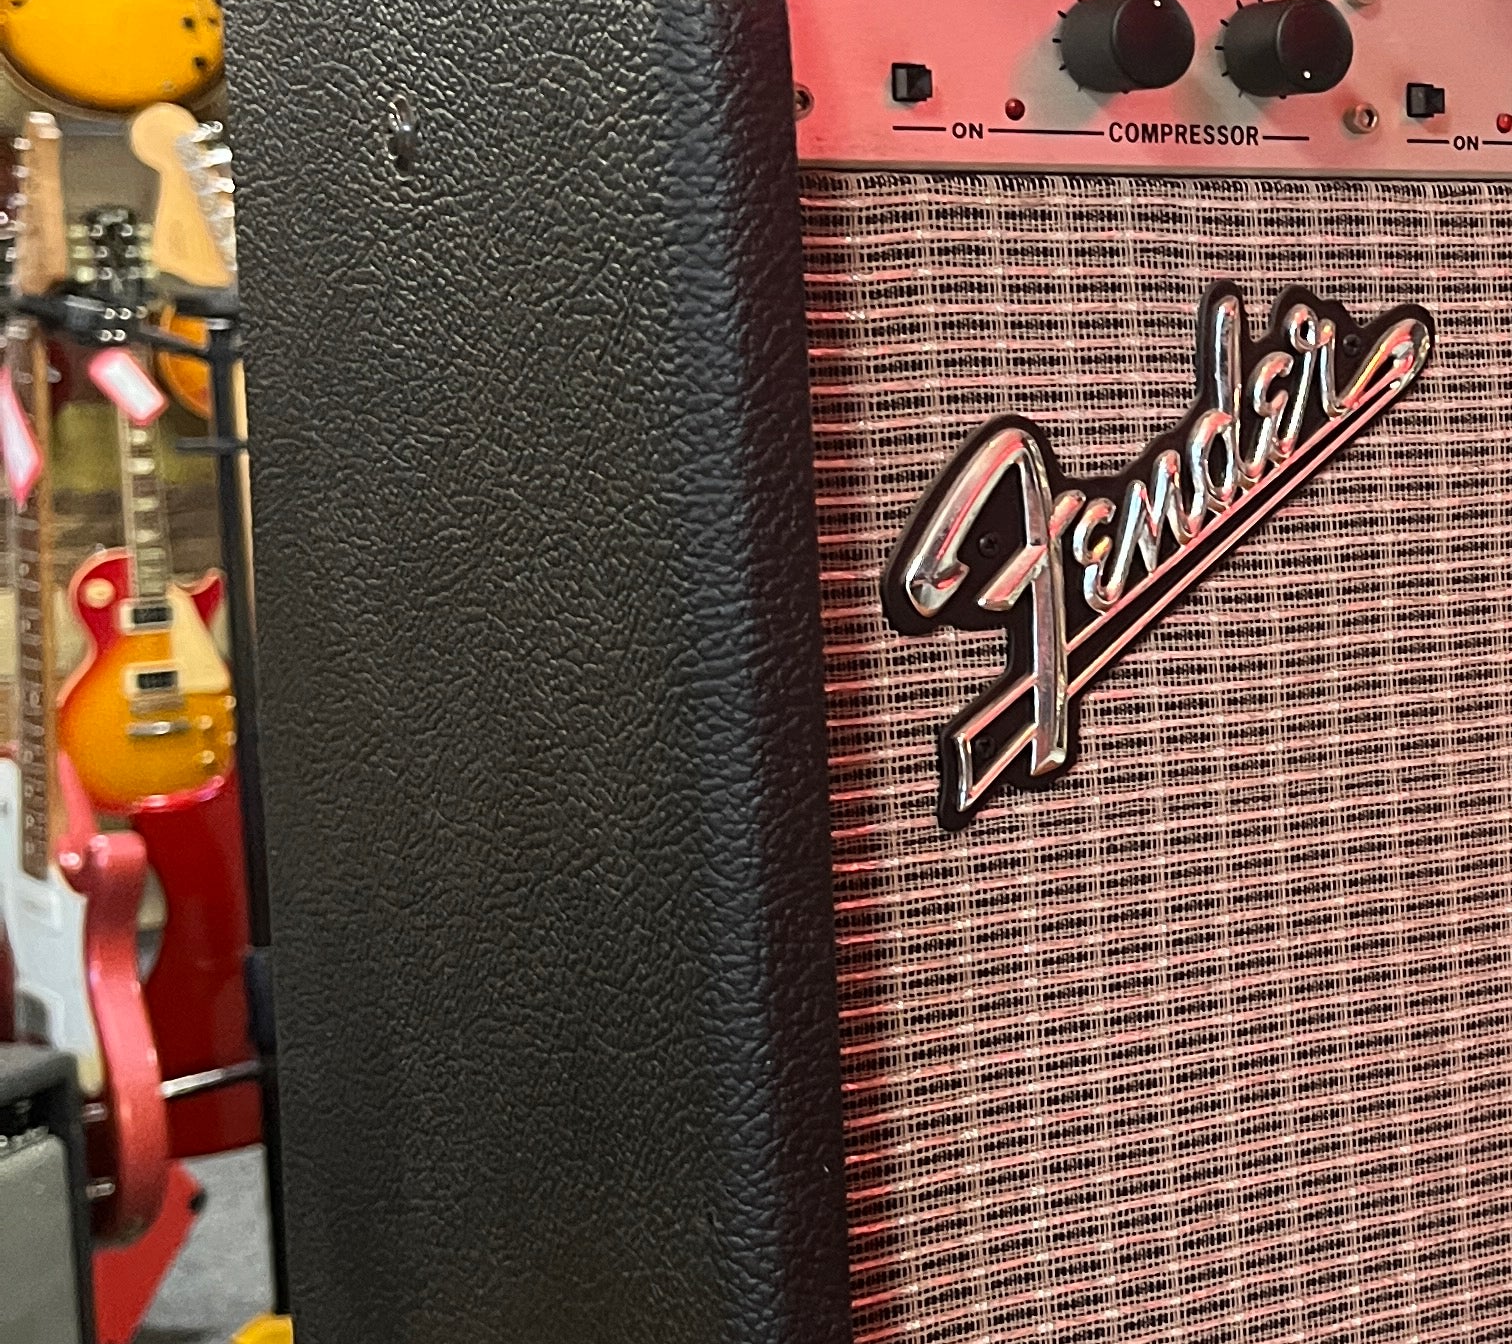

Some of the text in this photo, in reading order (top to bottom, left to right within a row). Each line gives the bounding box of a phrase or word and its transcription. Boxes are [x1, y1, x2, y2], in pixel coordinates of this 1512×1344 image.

[951, 122, 985, 141] ON
[1108, 121, 1260, 148] COMPRESSOR
[1453, 135, 1479, 151] ON
[900, 293, 1432, 813] Fender
